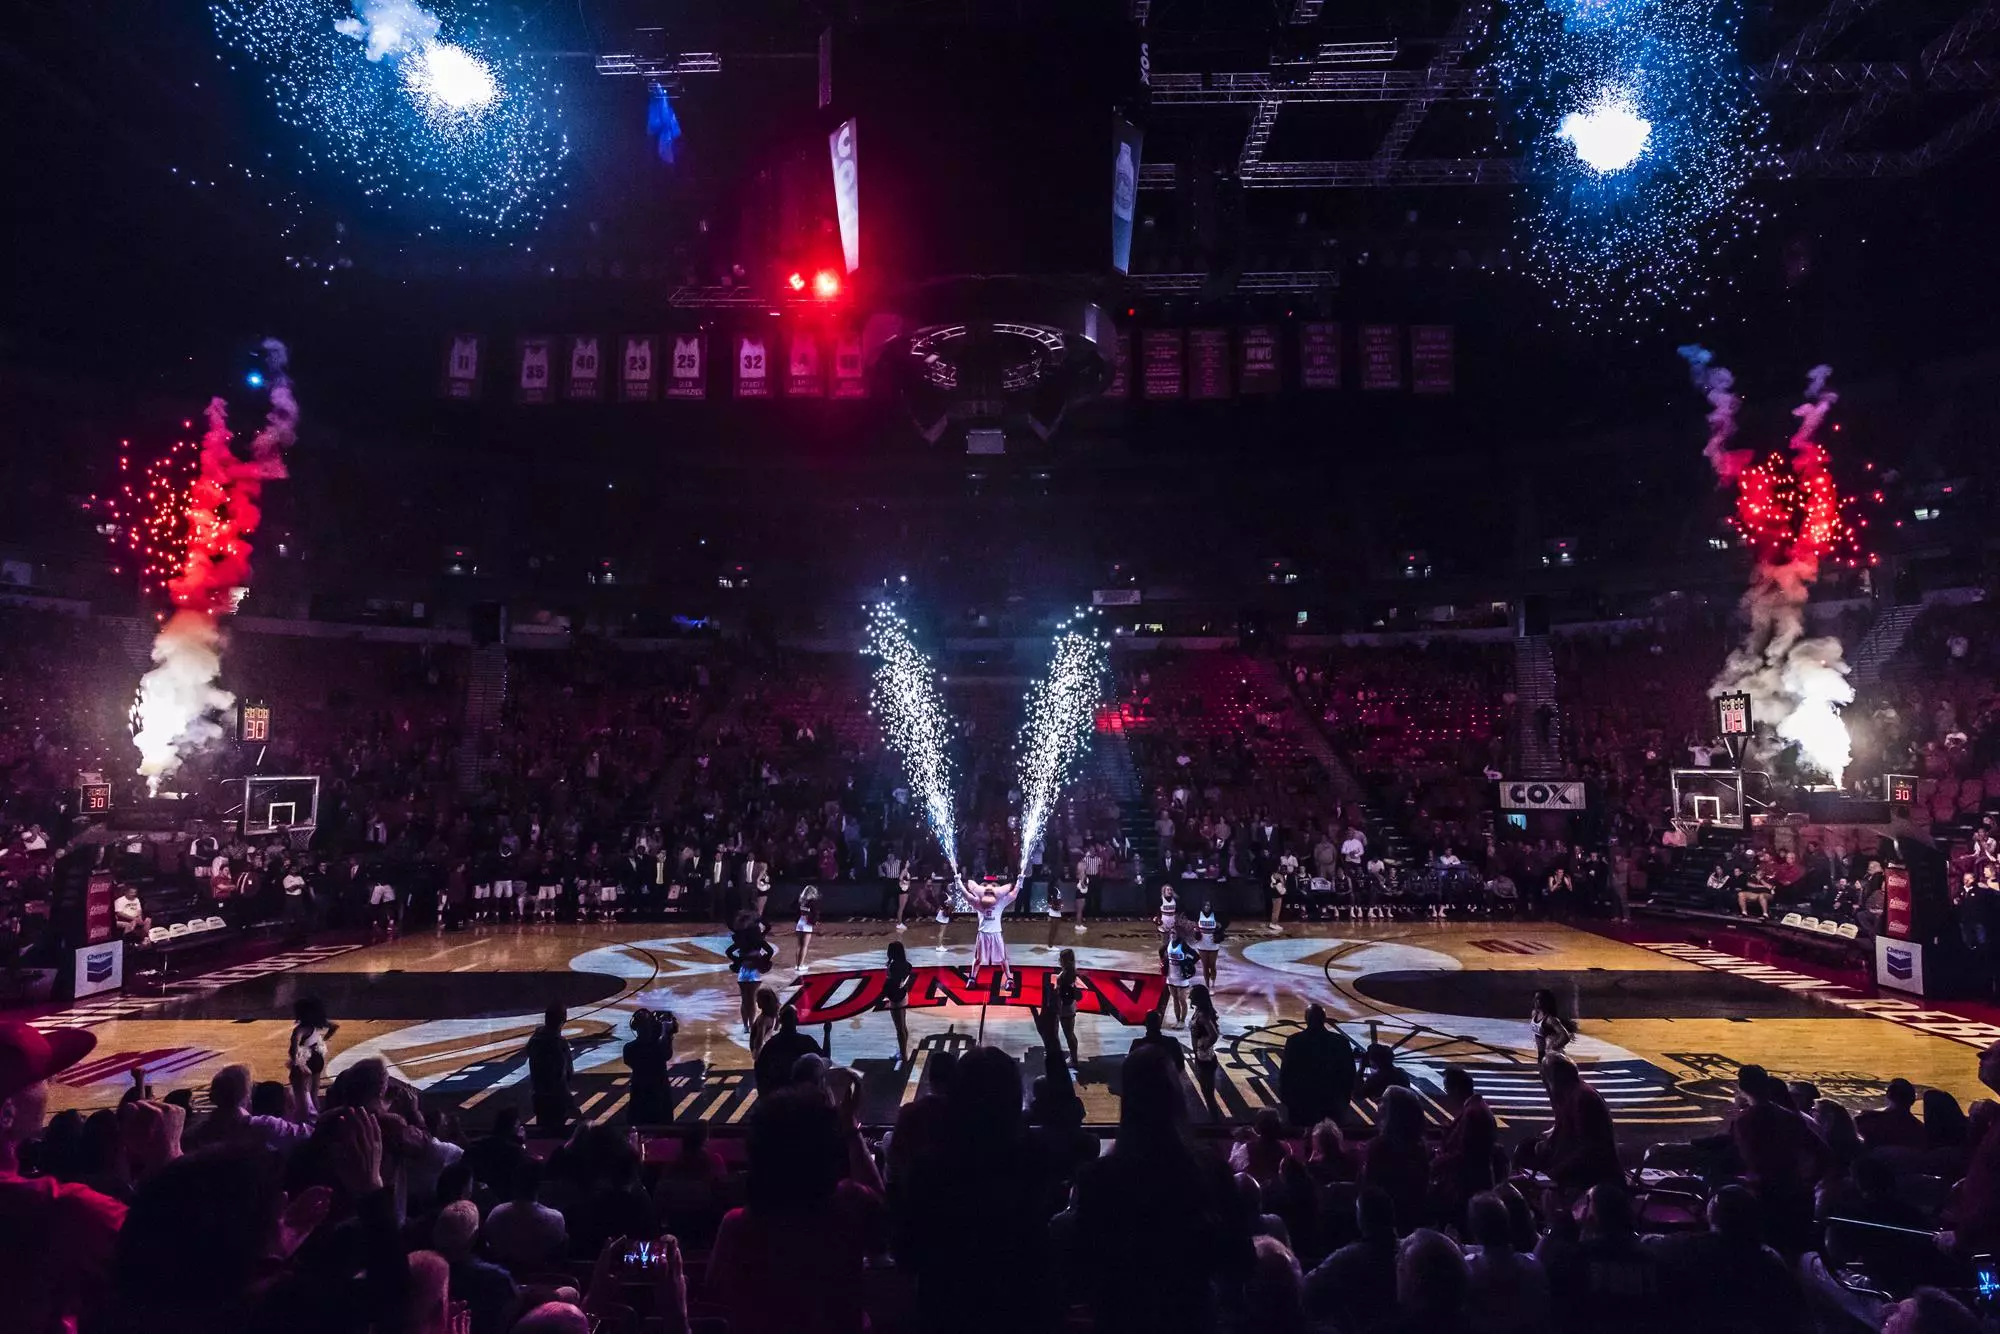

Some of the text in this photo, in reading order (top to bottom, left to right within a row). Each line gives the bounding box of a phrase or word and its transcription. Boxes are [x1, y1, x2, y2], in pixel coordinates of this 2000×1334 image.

[629, 355, 647, 371] 23
[676, 354, 696, 369] 25
[744, 354, 763, 369] 32
[247, 720, 265, 739] 30
[90, 797, 104, 808] 30
[1510, 783, 1573, 807] COX
[1895, 789, 1909, 801] 30
[87, 951, 113, 961] Chevron
[1886, 946, 1912, 957] Chevron
[785, 964, 1168, 1027] UNLV
